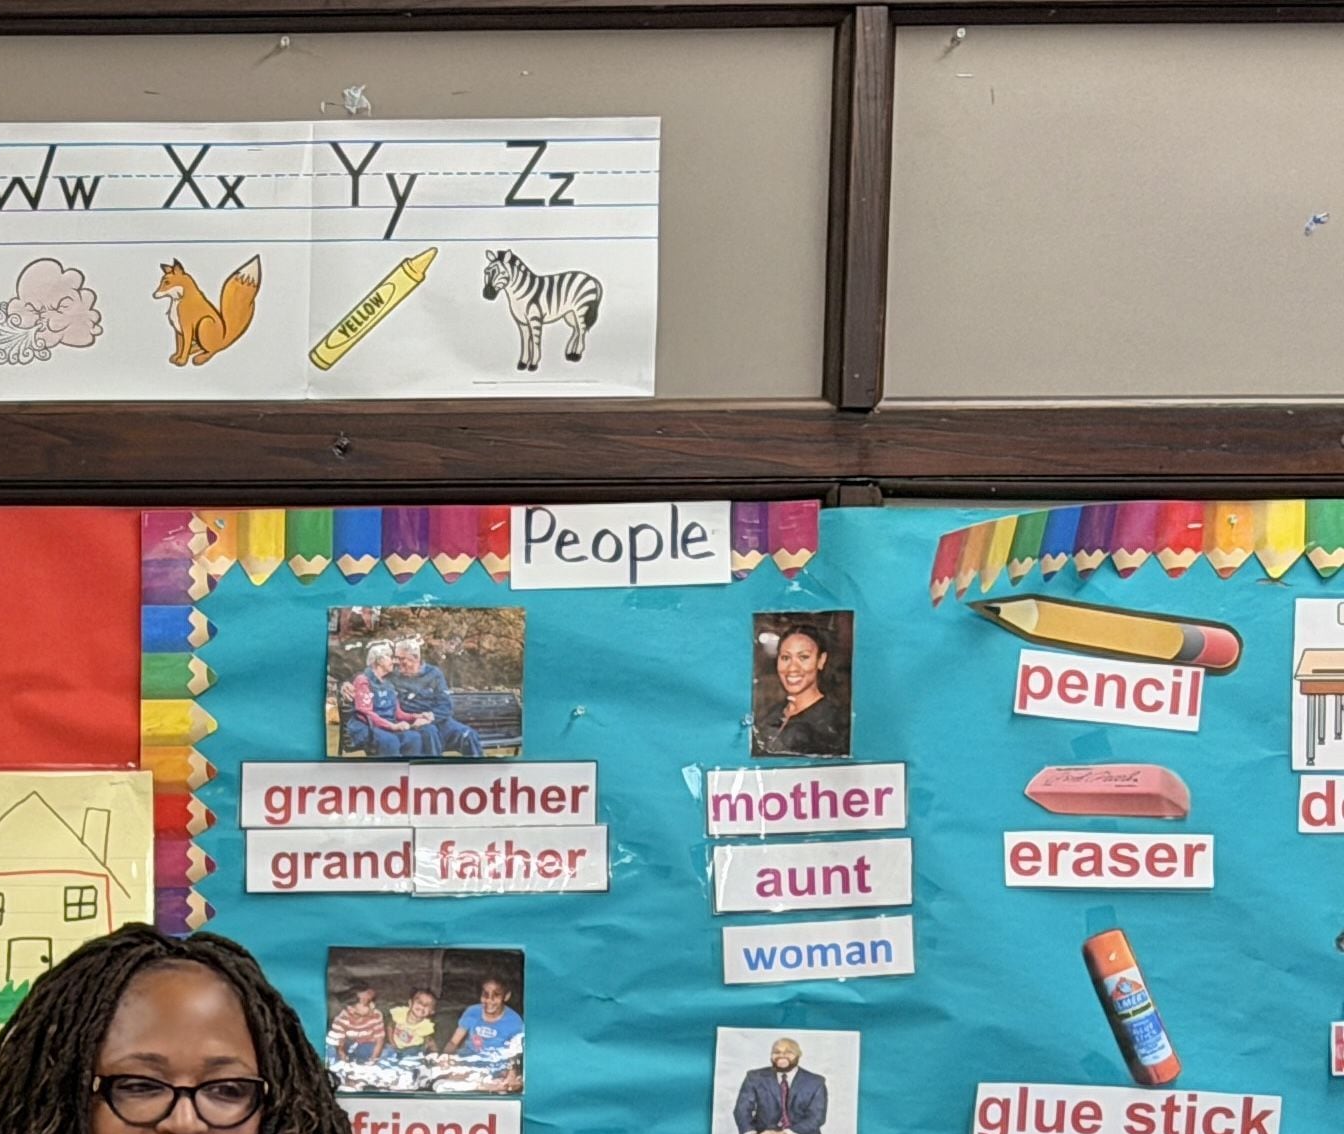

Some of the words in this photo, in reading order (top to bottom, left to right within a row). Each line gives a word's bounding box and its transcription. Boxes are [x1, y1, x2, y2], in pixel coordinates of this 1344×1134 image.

[164, 144, 243, 208] Xx
[331, 142, 414, 239] Yy
[506, 140, 573, 206] Zz
[338, 293, 385, 341] YELLOW
[523, 503, 715, 584] People
[1018, 662, 1205, 718] pencil
[264, 778, 589, 824] grandmother
[711, 782, 893, 821] mother
[271, 842, 411, 888] grand
[440, 841, 586, 880] father
[755, 855, 872, 896] aunt
[1010, 840, 1207, 877] eraser
[744, 937, 893, 972] woman
